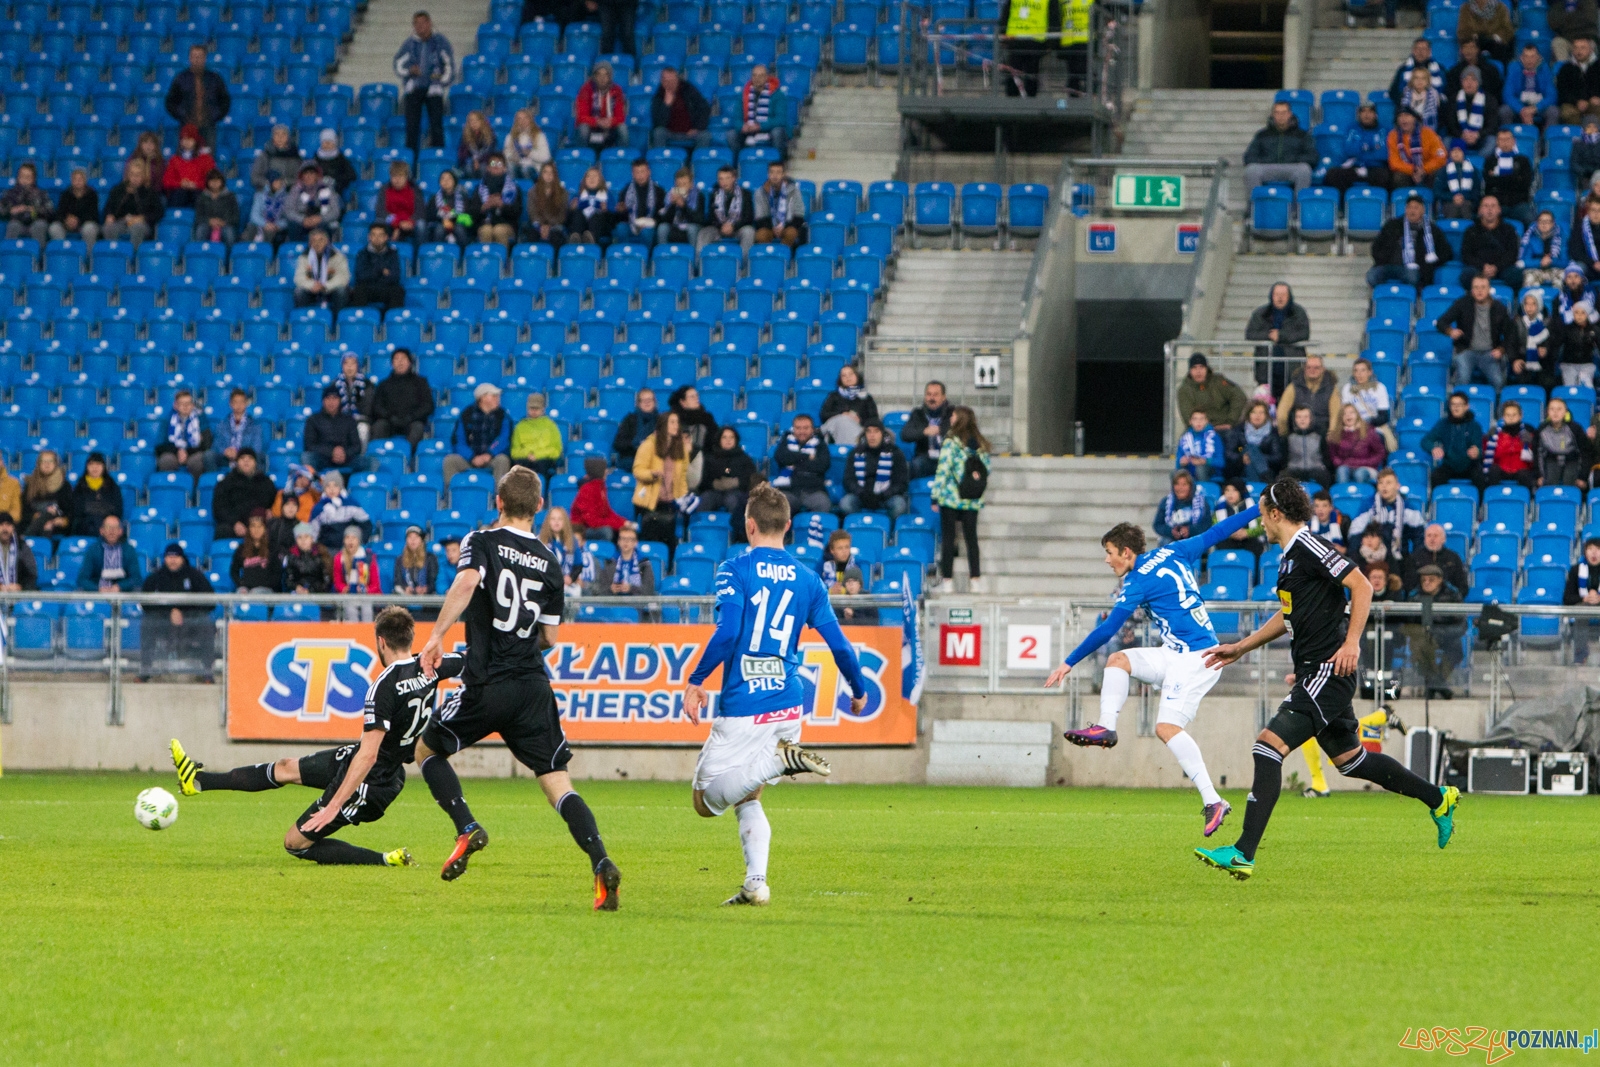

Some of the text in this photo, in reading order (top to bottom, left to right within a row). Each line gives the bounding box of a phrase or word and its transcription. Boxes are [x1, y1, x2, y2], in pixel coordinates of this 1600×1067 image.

[1095, 235, 1111, 248] L1
[497, 544, 549, 573] STĘPIŃSKI
[756, 562, 797, 584] GAJOS
[492, 568, 544, 639] 95
[749, 585, 795, 657] 14
[945, 632, 975, 659] M
[1018, 634, 1038, 659] 2
[258, 638, 379, 722] STS
[744, 660, 781, 674] LECH
[748, 677, 786, 694] PILS
